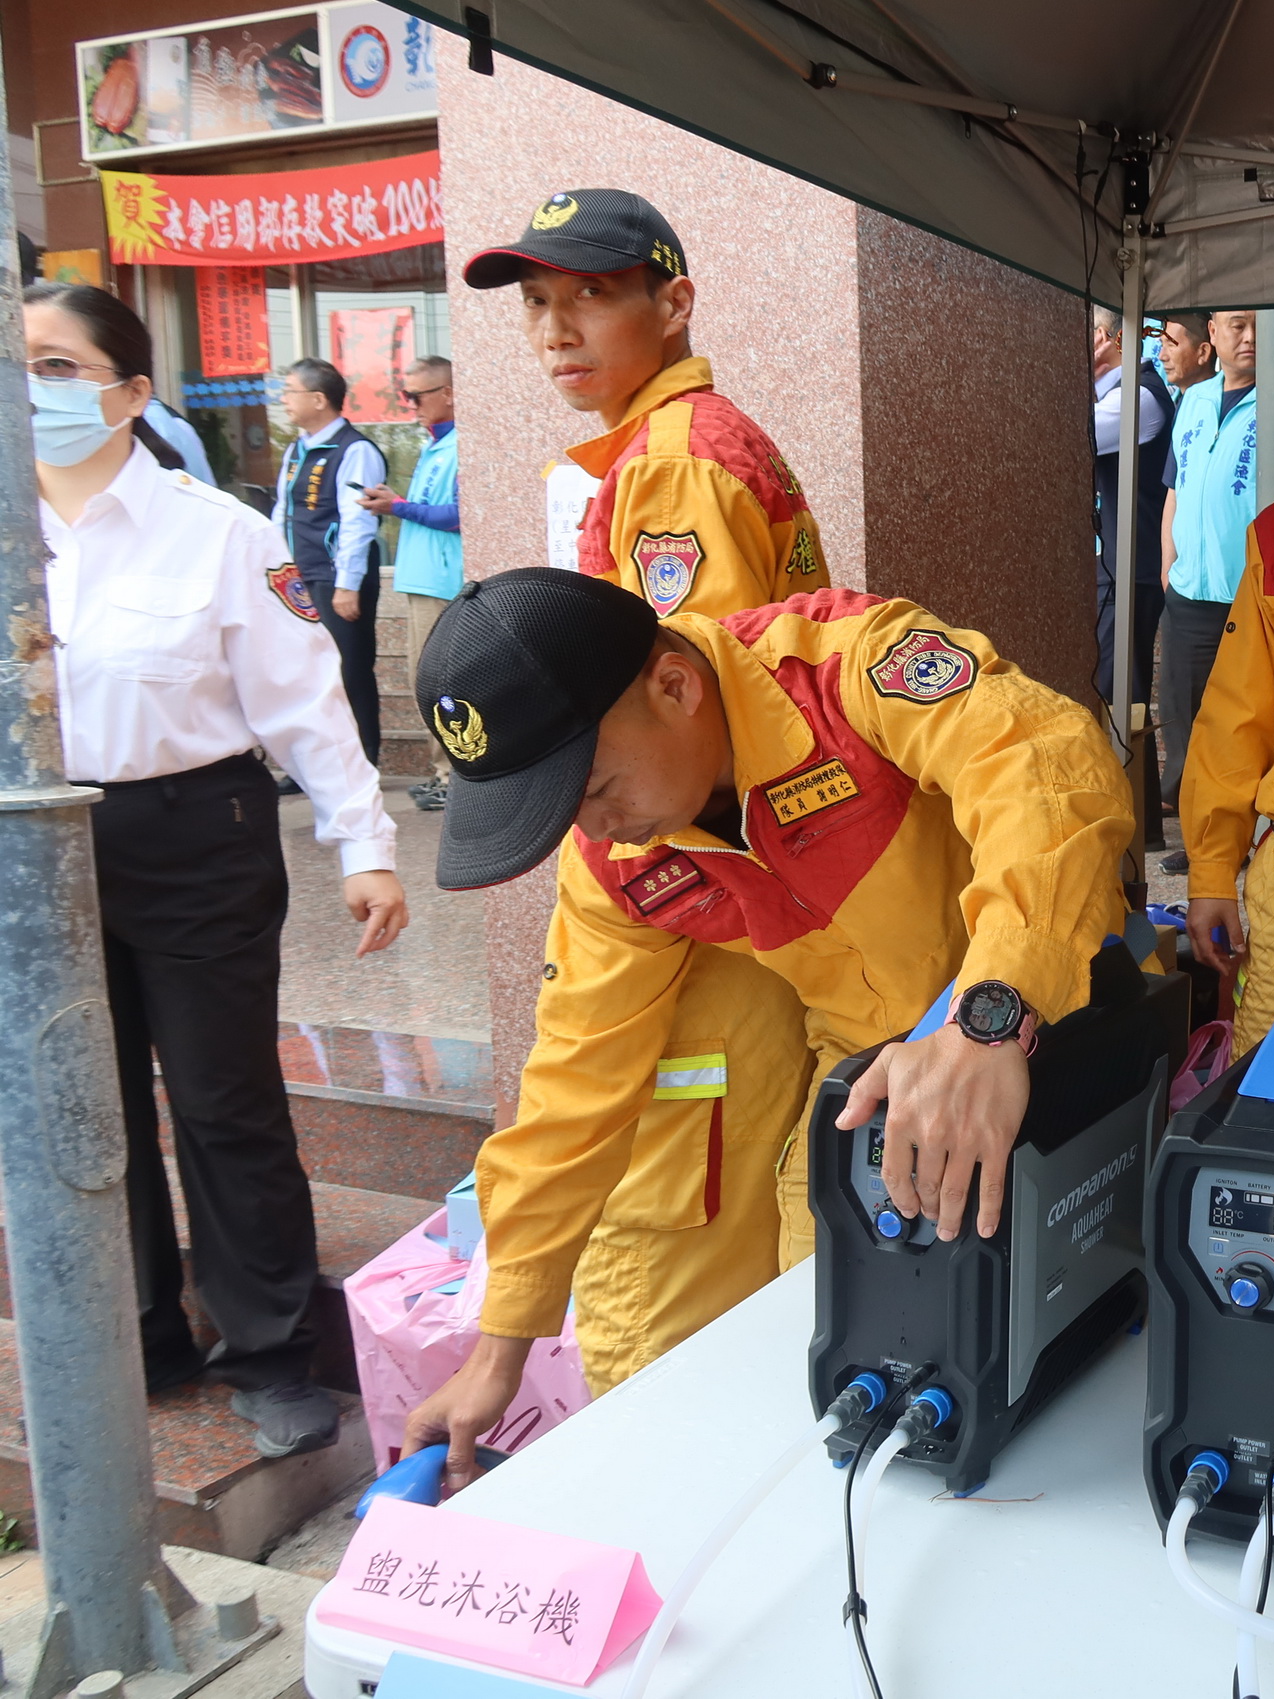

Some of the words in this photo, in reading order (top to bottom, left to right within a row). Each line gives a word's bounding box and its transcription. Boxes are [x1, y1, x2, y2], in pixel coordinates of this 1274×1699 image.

[878, 635, 931, 682] 彰化縣消防局
[1071, 1193, 1114, 1243] AQUAHEAT
[1080, 1225, 1104, 1254] SHOWER
[1233, 1436, 1247, 1444] PUMP
[1248, 1440, 1266, 1448] POWER
[1240, 1444, 1258, 1453] OUTLET
[1234, 1454, 1253, 1462] OUTLET
[353, 1550, 581, 1646] 盥洗沐浴機
